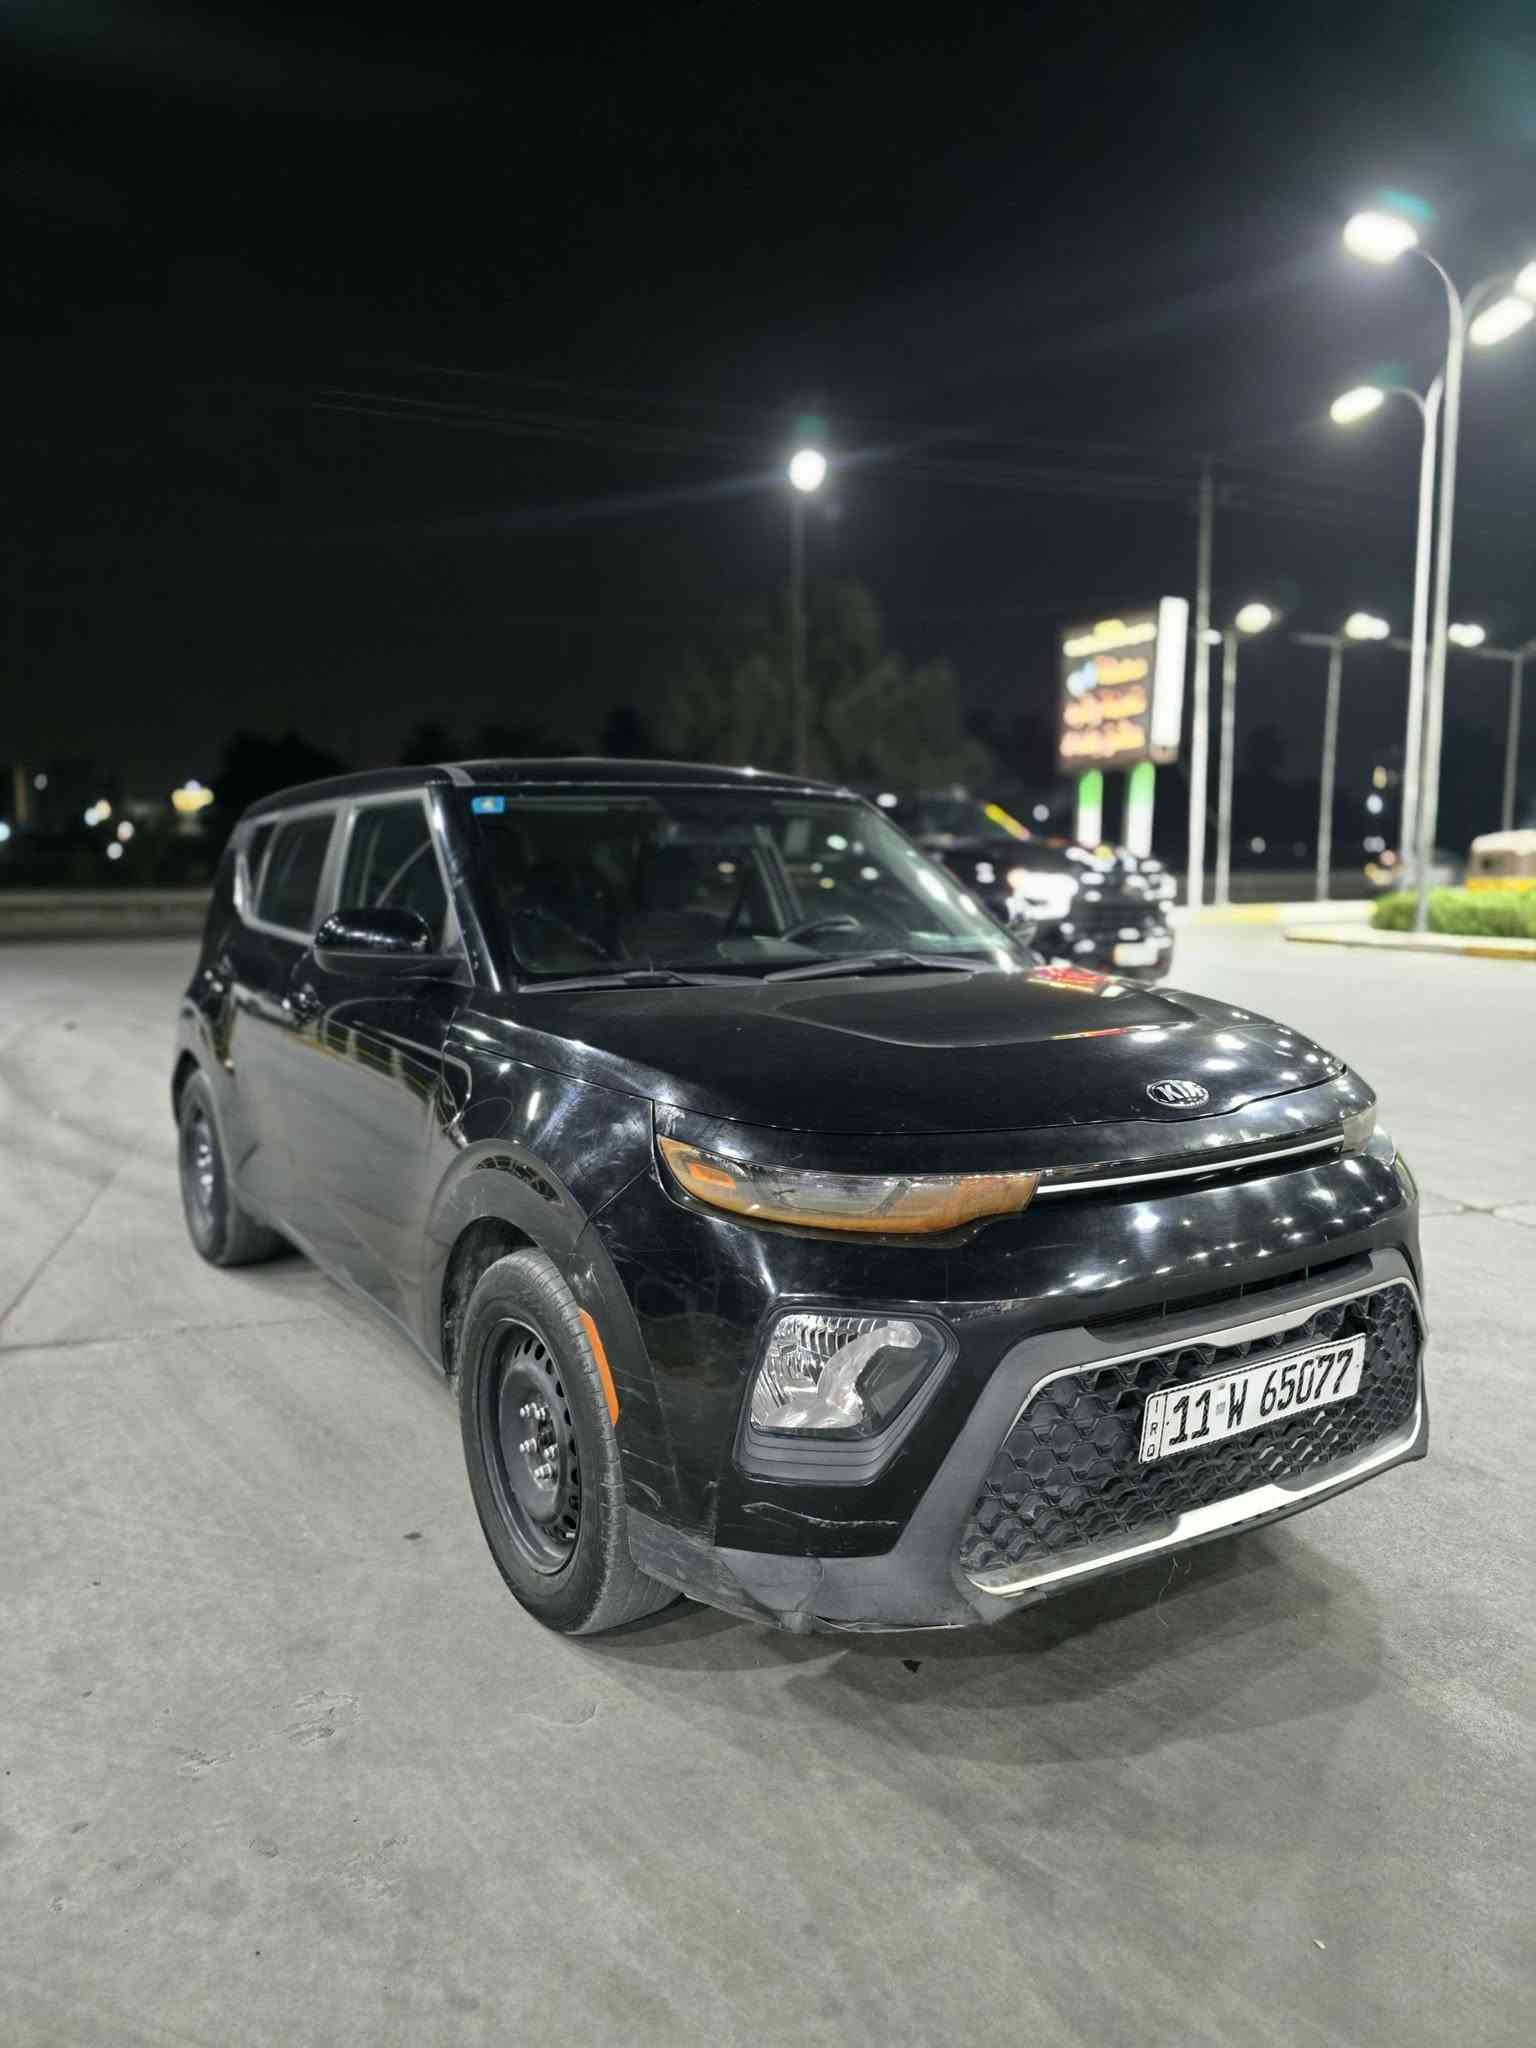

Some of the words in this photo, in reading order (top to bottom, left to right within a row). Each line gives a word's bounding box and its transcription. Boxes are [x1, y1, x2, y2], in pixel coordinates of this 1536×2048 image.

[1155, 1083, 1203, 1103] KIA
[1169, 1389, 1211, 1446] 11
[1226, 1378, 1248, 1429] W
[1259, 1347, 1354, 1417] 65077
